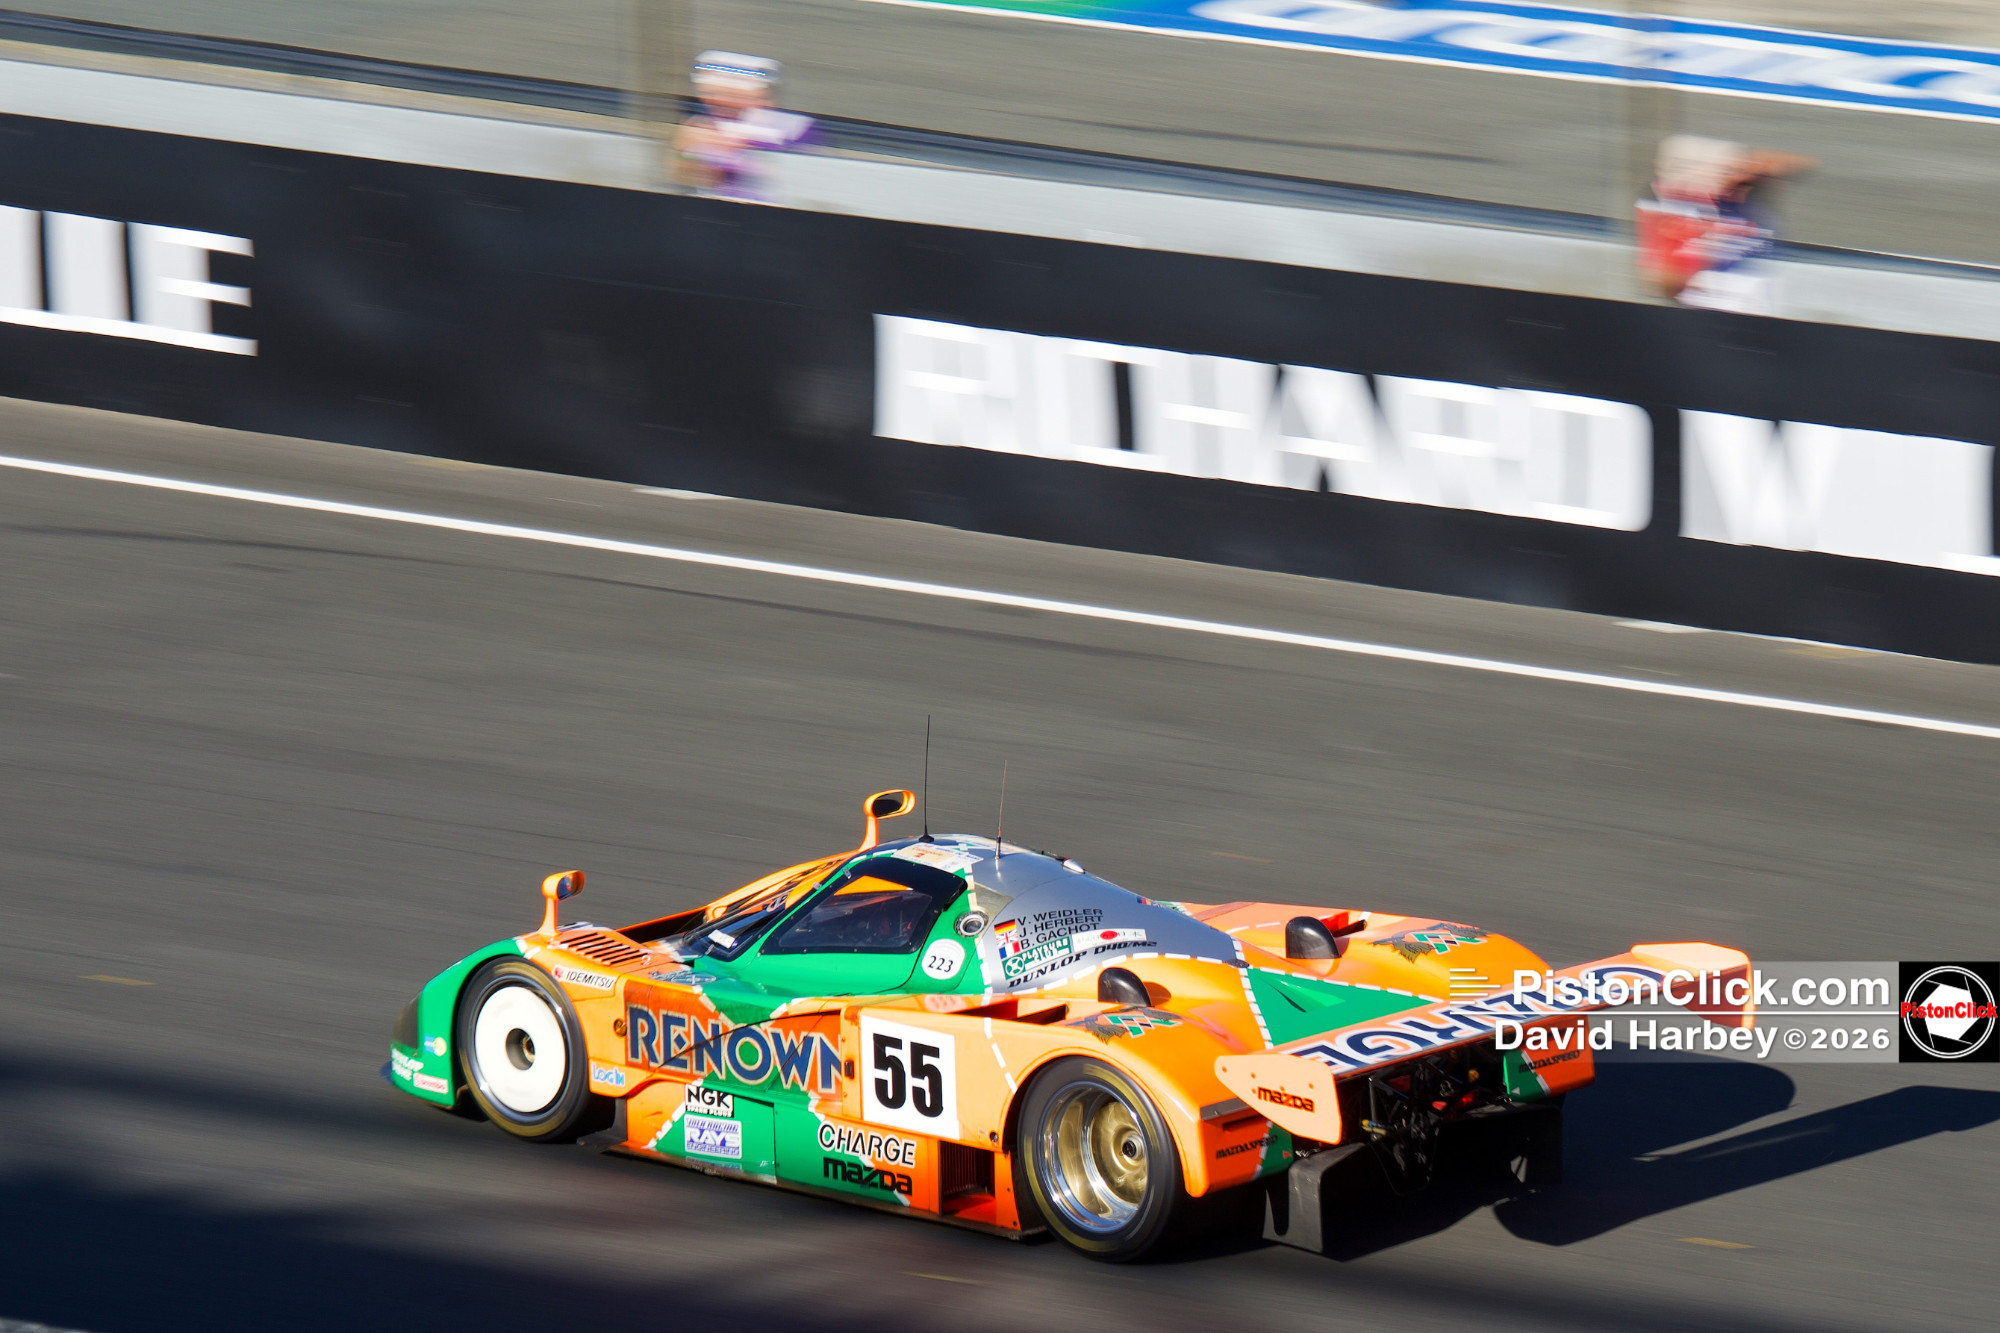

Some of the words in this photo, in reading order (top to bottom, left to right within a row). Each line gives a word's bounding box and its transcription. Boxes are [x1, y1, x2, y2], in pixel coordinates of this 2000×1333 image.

[873, 313, 1652, 532] RICHARD
[1033, 908, 1103, 922] WEIDLER
[1034, 915, 1103, 931] HERBERT
[1036, 922, 1100, 944] GACHOT
[928, 955, 954, 973] 223
[1008, 950, 1087, 988] DUNLOP
[566, 970, 614, 989] IDEMITSU
[626, 1003, 842, 1094] RENOWN
[873, 1032, 944, 1118] 55
[687, 1086, 730, 1109] NGK
[687, 1128, 740, 1148] RAYS
[819, 1124, 916, 1166] CHARGE
[823, 1157, 913, 1196] mazda
